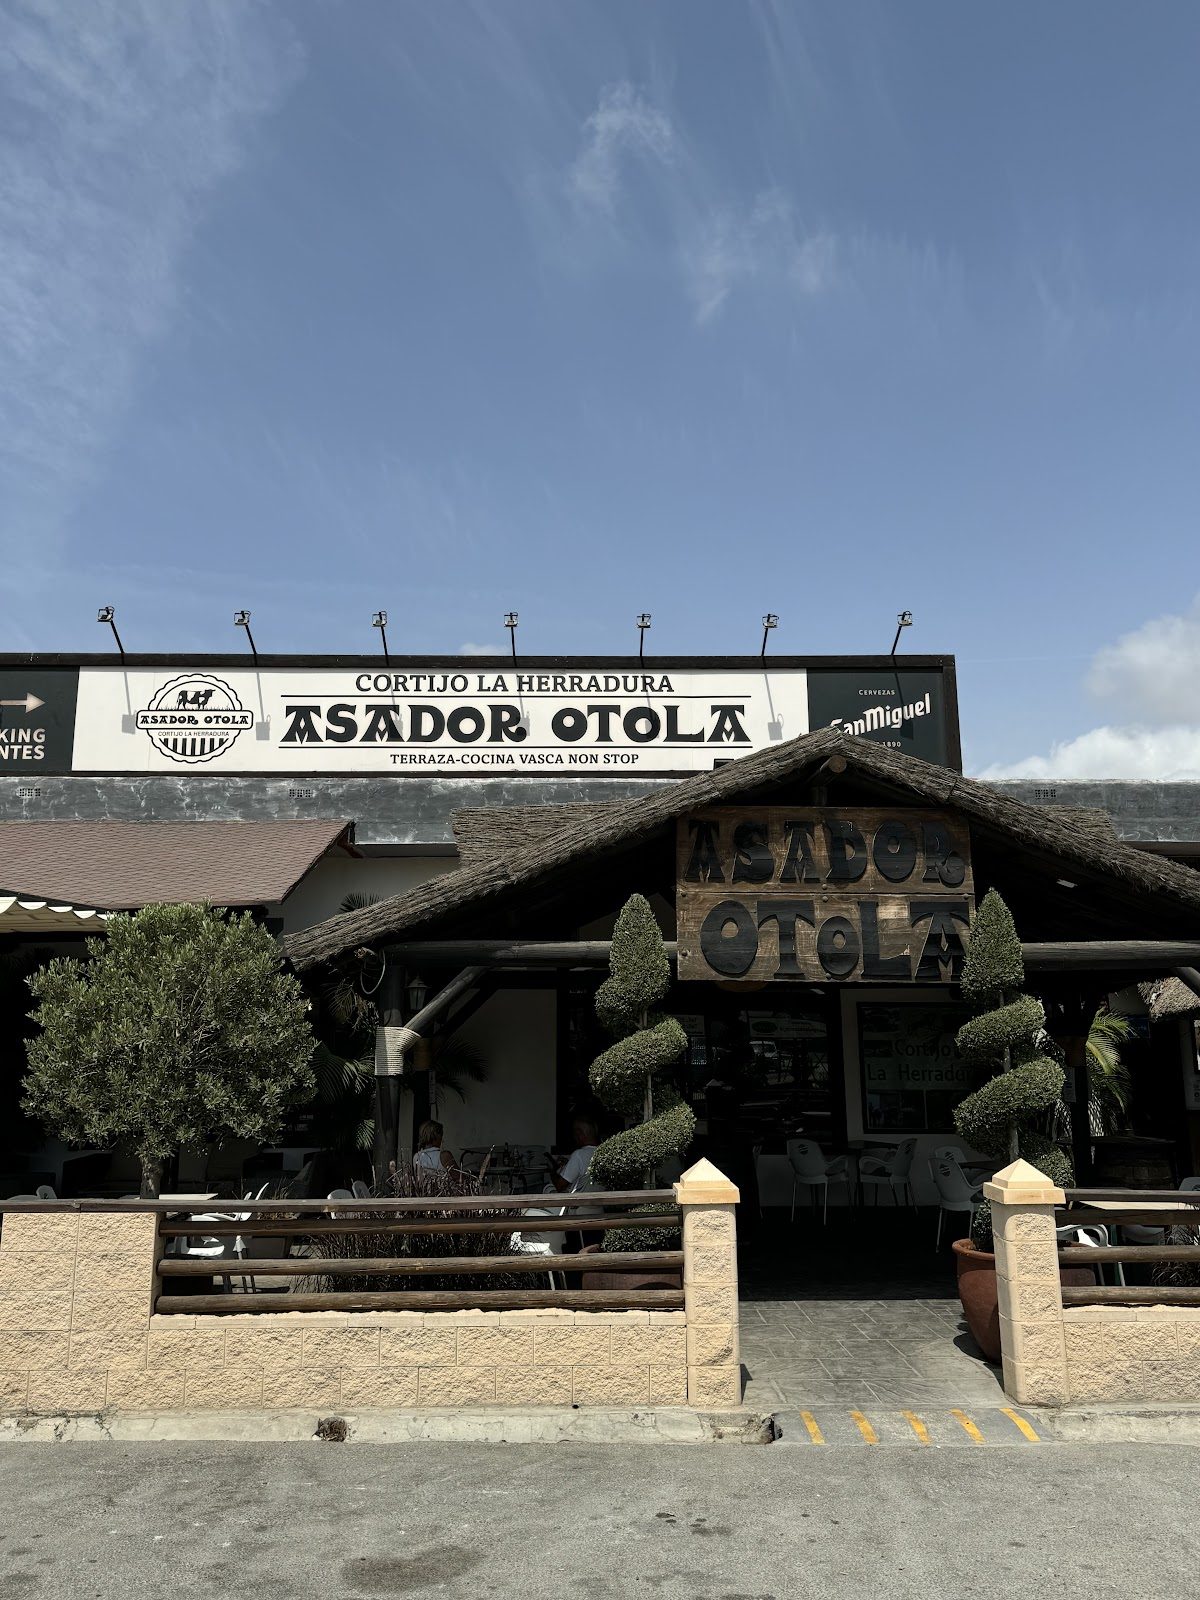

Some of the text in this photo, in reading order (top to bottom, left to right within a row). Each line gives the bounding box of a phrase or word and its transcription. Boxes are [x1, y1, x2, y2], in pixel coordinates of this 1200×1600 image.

[355, 674, 675, 693] CORTIJO LA HERRADURA
[140, 715, 249, 725] ASADOR OTOLA
[279, 703, 752, 745] ASADOR OTOLA
[390, 753, 640, 765] TERRAZA-COCINA VASCA NON STOP
[684, 819, 966, 888] ASADOR
[700, 899, 970, 981] OTOLA
[866, 1063, 887, 1081] La
